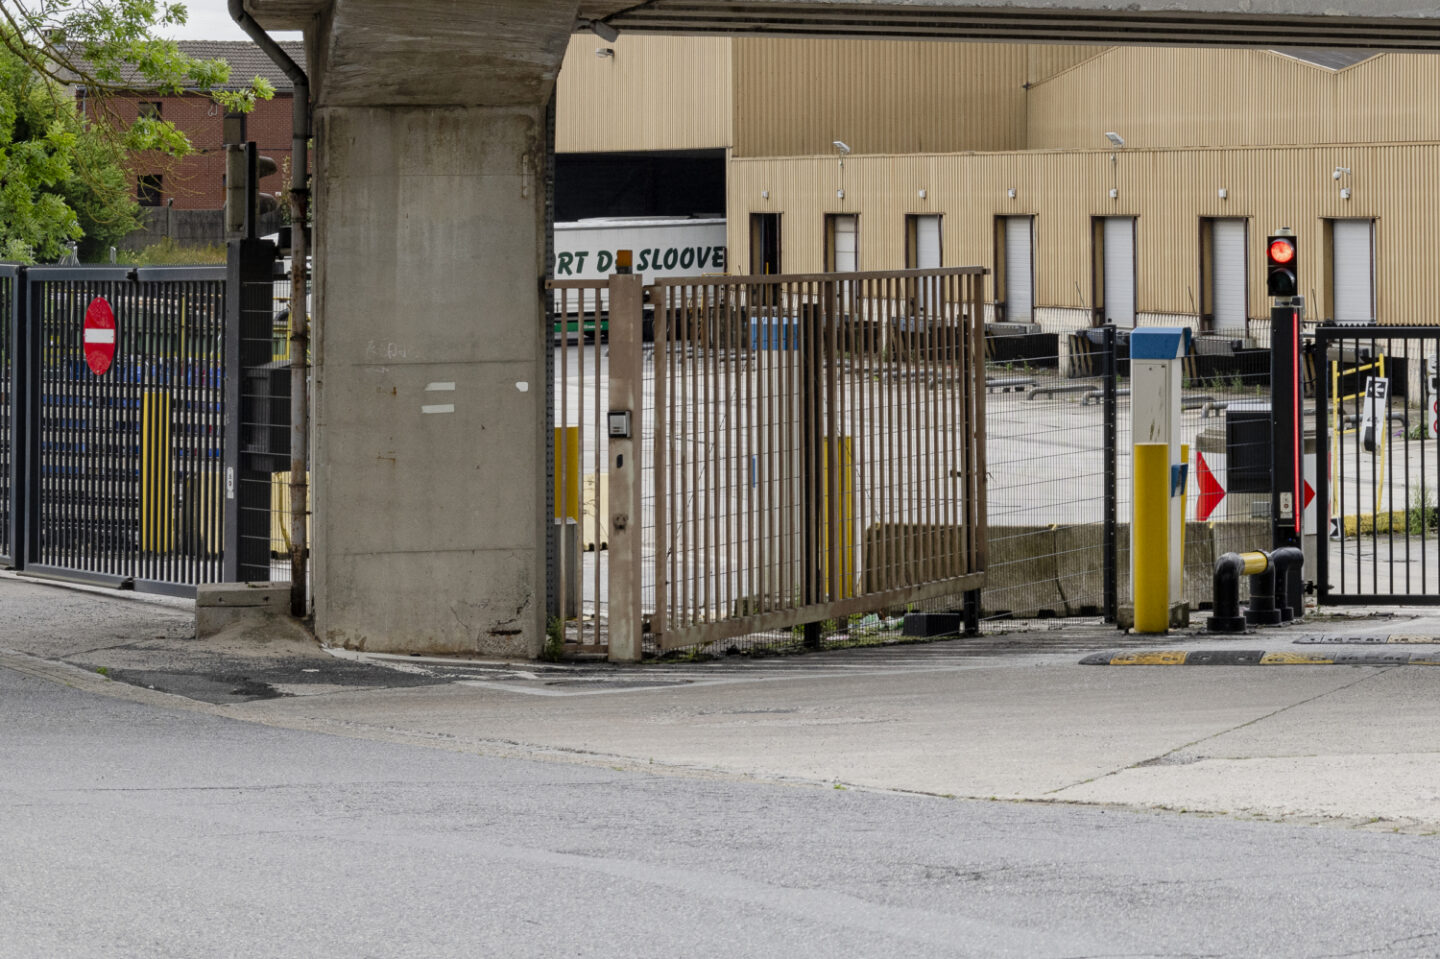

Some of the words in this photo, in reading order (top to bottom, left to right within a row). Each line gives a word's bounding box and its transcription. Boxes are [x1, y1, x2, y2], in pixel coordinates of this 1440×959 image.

[554, 251, 589, 276] RT
[597, 250, 617, 273] D
[636, 246, 725, 272] SLOOVE
